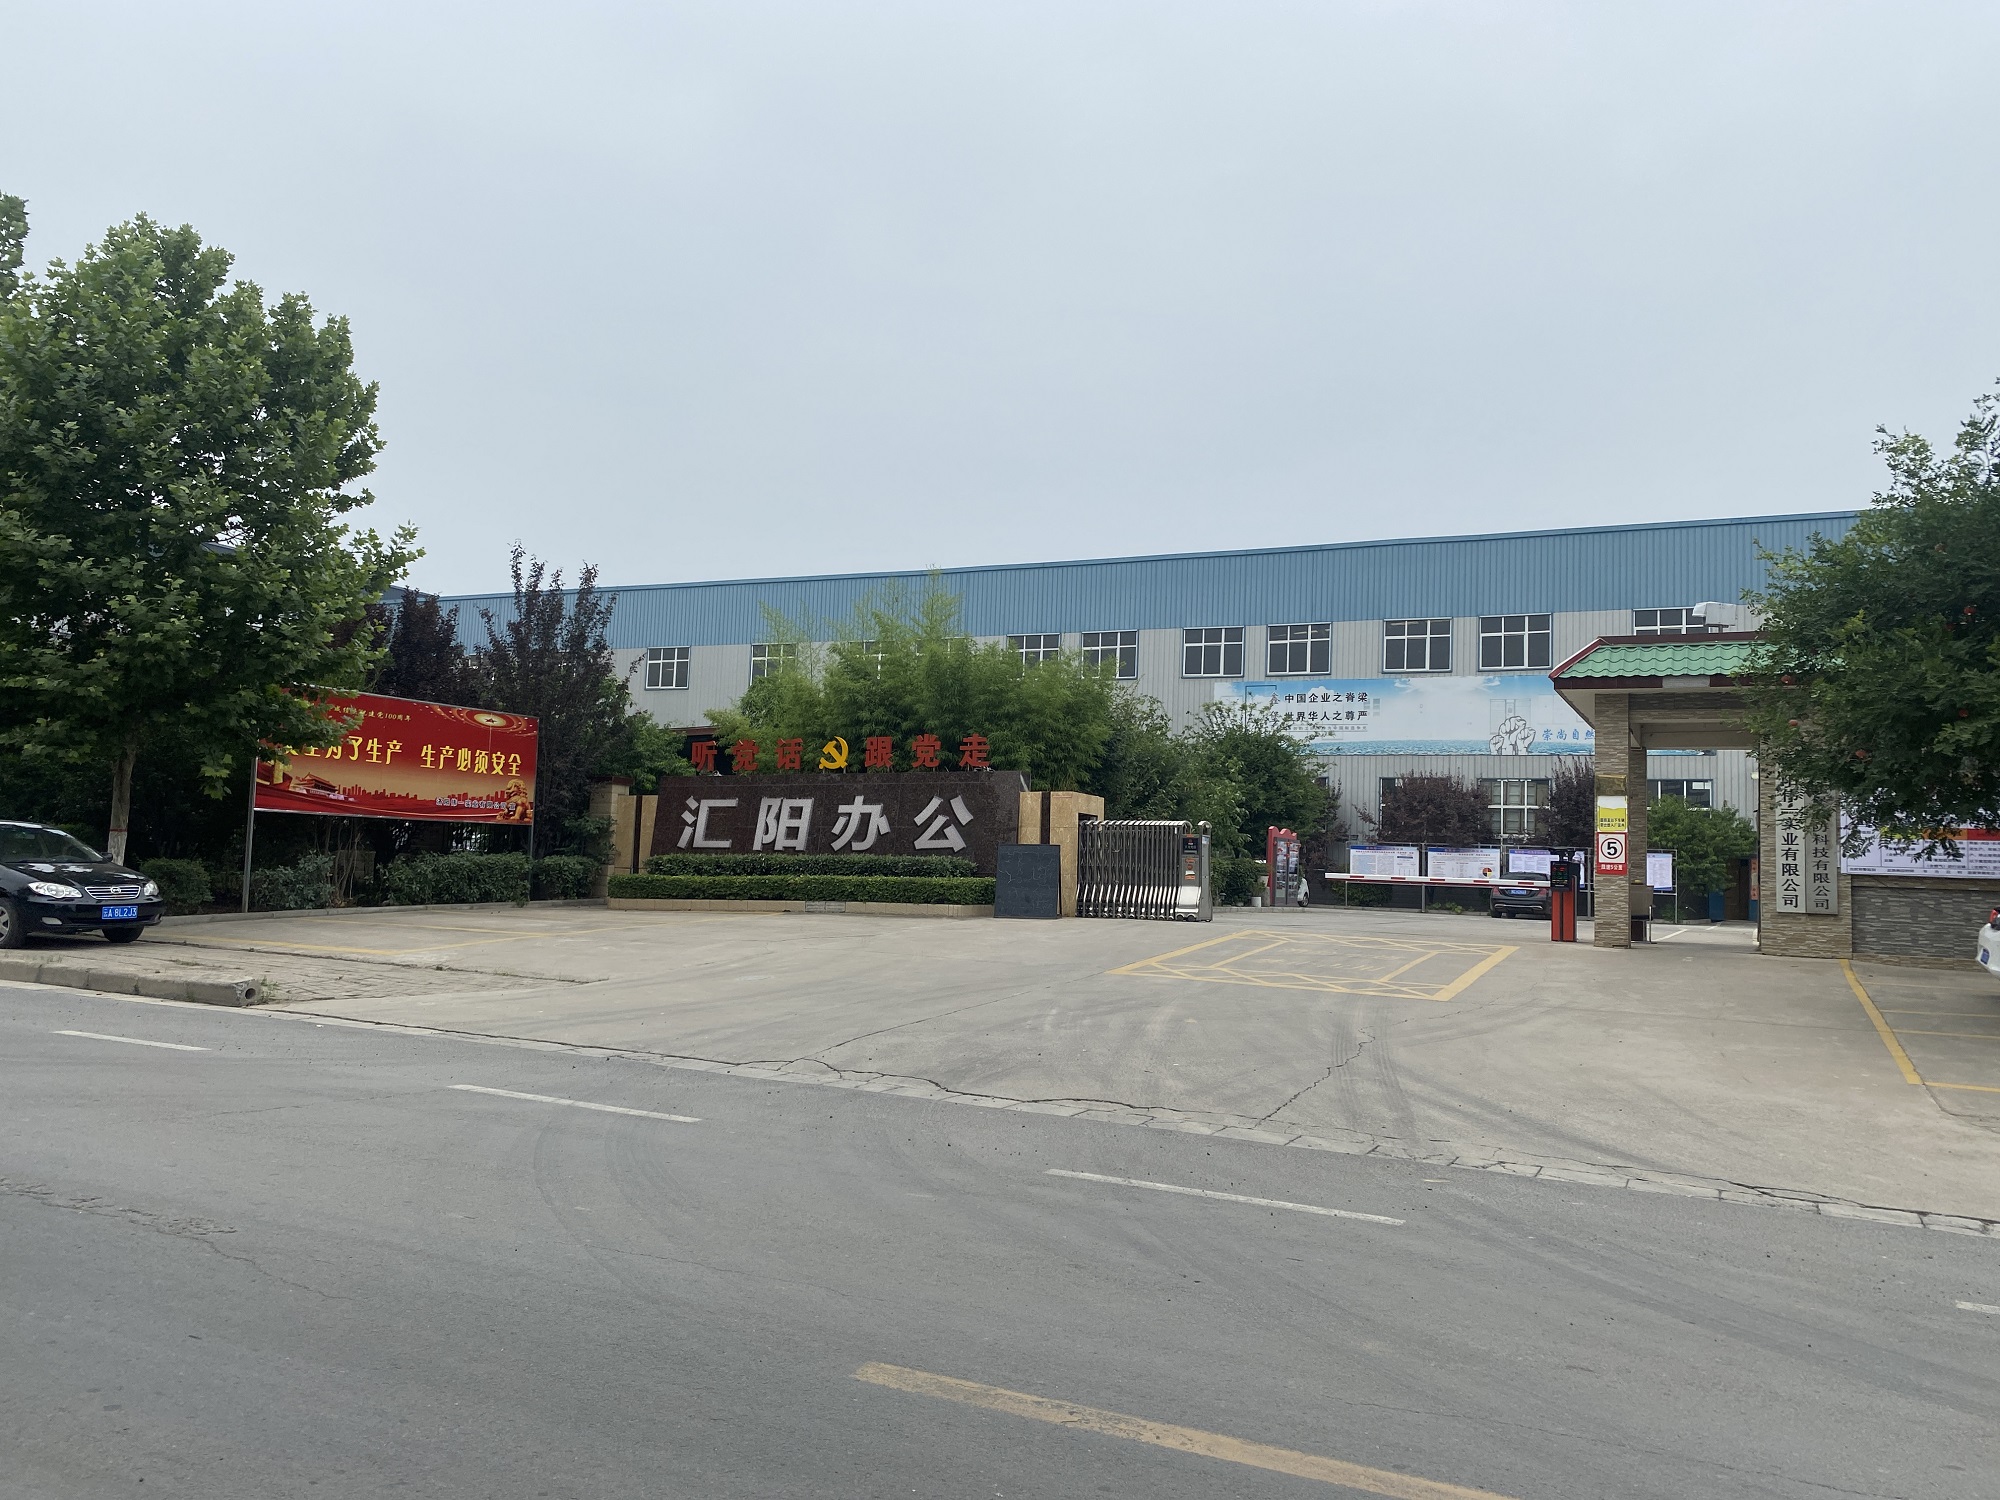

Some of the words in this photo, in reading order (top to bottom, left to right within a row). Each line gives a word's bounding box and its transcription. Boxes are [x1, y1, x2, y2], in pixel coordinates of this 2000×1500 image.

[1284, 692, 1368, 704] 中国企业之脊梁
[420, 744, 522, 777] 生产必须安全
[691, 739, 804, 772] 听党话
[864, 733, 992, 769] 跟党走
[677, 795, 974, 853] 汇阳办公
[1607, 842, 1617, 855] 5
